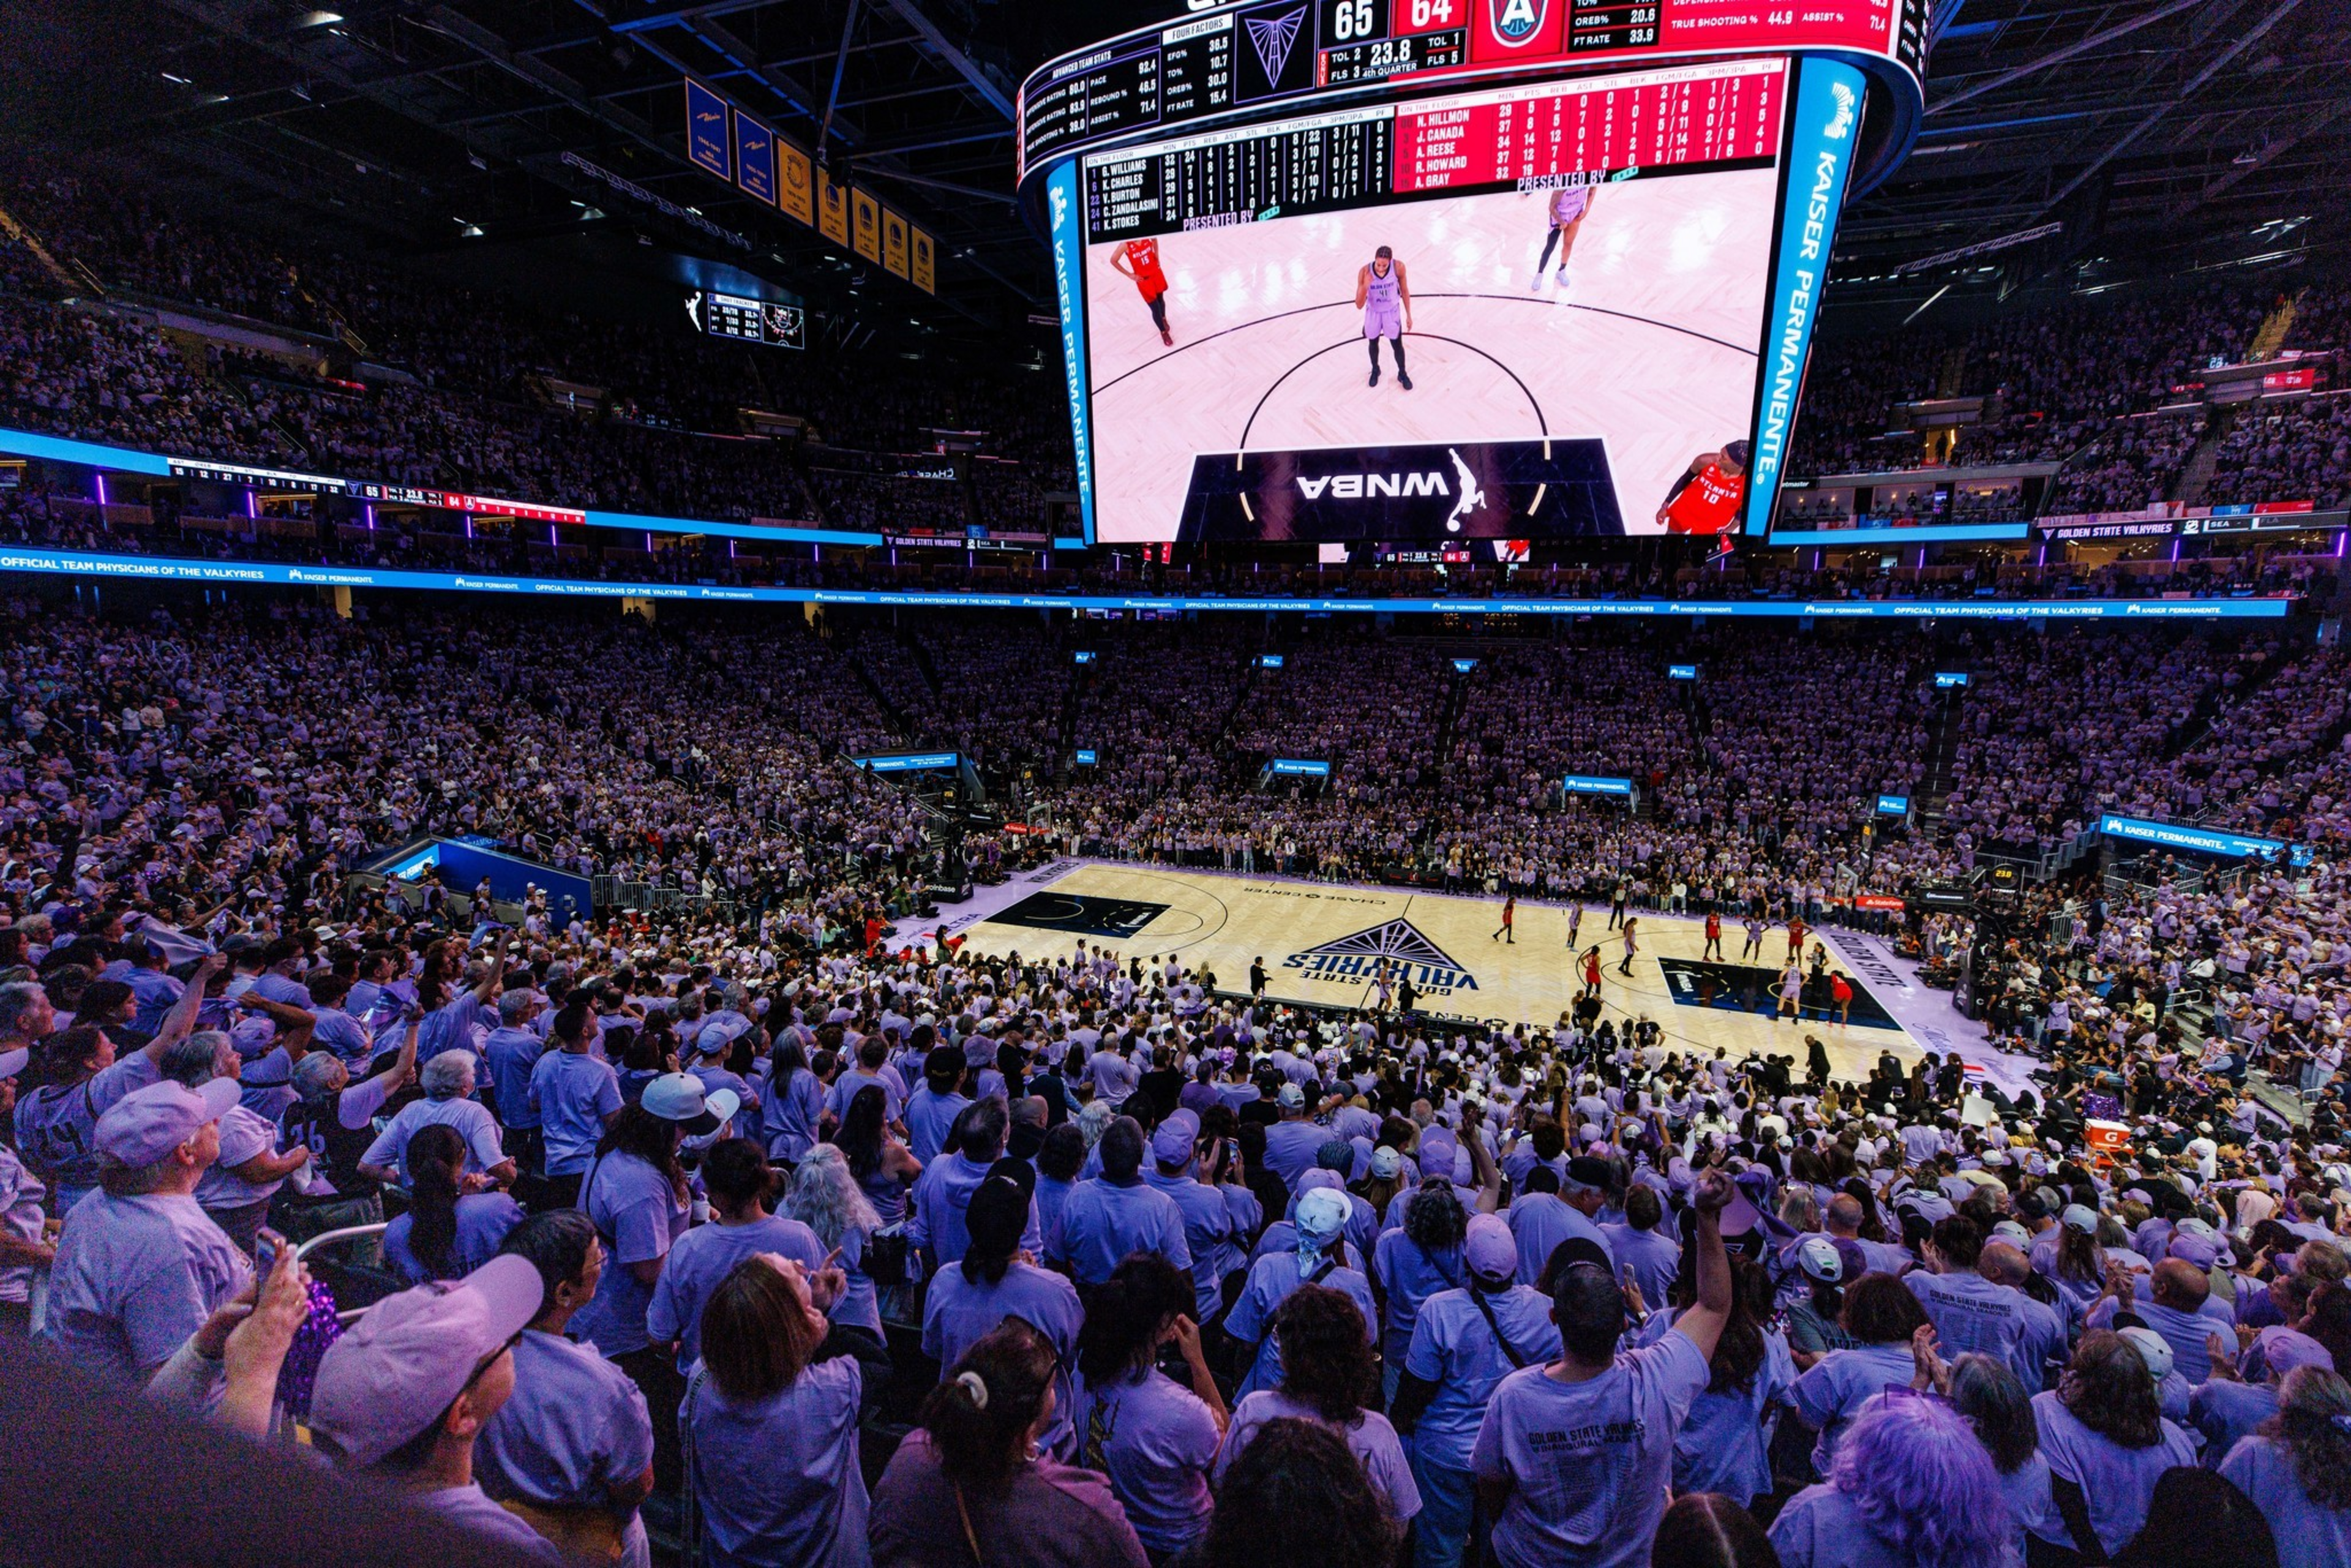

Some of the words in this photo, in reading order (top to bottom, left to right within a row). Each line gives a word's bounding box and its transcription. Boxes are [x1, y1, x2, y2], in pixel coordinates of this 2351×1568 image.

[1335, 0, 1373, 40] 65
[1411, 0, 1452, 27] 64
[1575, 15, 1609, 26] OREB%
[1630, 8, 1655, 23] 20.6
[1672, 19, 1695, 29] TRUE
[1698, 16, 1747, 28] SHOOTING
[1768, 11, 1793, 25] 44.9
[1802, 12, 1834, 22] ASSIST
[1870, 15, 1886, 31] 71.4
[1172, 26, 1190, 40] FOUR
[1191, 18, 1223, 35] FACTORS
[1574, 37, 1585, 46] FT
[1587, 34, 1610, 45] RATE
[1630, 28, 1654, 43] 33.9
[1428, 37, 1447, 48] TOL
[1454, 32, 1460, 45] 1
[1167, 49, 1188, 61] EFG%
[1331, 52, 1349, 63] TOL
[1354, 47, 1361, 61] 2
[1370, 39, 1411, 67] 23.8
[1427, 55, 1445, 66] FLS
[1451, 50, 1458, 64] 5
[1052, 62, 1079, 80] ADVANCED
[1079, 56, 1093, 70] TEAM
[1094, 50, 1112, 64] STATS
[1090, 75, 1107, 88] PACE
[1138, 58, 1157, 75] 92.4
[1168, 67, 1183, 78] TO%
[1210, 54, 1228, 70] 10.7
[1331, 70, 1348, 81] FLS
[1353, 65, 1360, 79] 3
[1362, 69, 1376, 78] 4th
[1378, 62, 1417, 76] QUARTER
[1046, 88, 1066, 104] RATING
[1069, 80, 1086, 96] 80.0
[1167, 82, 1193, 96] OREB%
[1207, 72, 1228, 88] 30.0
[1090, 91, 1120, 107] REBOUND
[1166, 103, 1176, 113] FT
[1176, 99, 1194, 110] RATE
[1209, 89, 1228, 105] 15.4
[1046, 107, 1066, 122] RATING
[1090, 112, 1112, 126] ASSIST
[1140, 99, 1157, 114] 71.4
[1417, 116, 1427, 129] N.
[1429, 109, 1470, 127] HILLMON
[1069, 118, 1086, 133] 39.0
[1416, 131, 1425, 144] J.
[1427, 126, 1464, 143] CANADA
[1112, 151, 1134, 160] FLOOR
[1415, 146, 1425, 159] A.
[1427, 141, 1456, 157] REESE
[1110, 159, 1147, 176] WILLIAMS
[1415, 161, 1425, 174] R.
[1427, 156, 1468, 173] HOWARD
[1103, 179, 1110, 191] K.
[1111, 173, 1144, 190] CHARLES
[1415, 176, 1424, 189] A.
[1426, 173, 1450, 187] GRAY
[1517, 171, 1586, 192] PRESENTED
[1589, 169, 1607, 184] BY
[1103, 193, 1111, 204] V.
[1111, 187, 1141, 203] BURTON
[1103, 206, 1111, 218] C.
[1112, 198, 1159, 216] ZANDALASINI
[1800, 151, 1837, 261] KAISER
[1104, 219, 1111, 231] K.
[1112, 214, 1140, 230] STOKES
[1183, 211, 1238, 232] PRESENTED
[1240, 209, 1254, 223] BY
[1054, 239, 1071, 323] KAISER
[366, 486, 379, 497] 65
[405, 489, 424, 500] 23.8
[1296, 471, 1450, 500] WNBA
[1699, 475, 1738, 499] ATLANTA
[1702, 490, 1720, 505] 10
[2057, 527, 2090, 539] GOLDEN
[2091, 525, 2122, 538] STATE
[2123, 523, 2173, 536] VALKYRIES
[895, 538, 916, 546] GOLDEN
[1, 557, 59, 569] OFFICIAL
[61, 560, 94, 571] TEAM
[96, 562, 159, 575] PHYSICIANS
[160, 566, 176, 576] OF
[178, 567, 201, 577] THE
[203, 568, 265, 579] VALKYRIES
[535, 583, 565, 593] OFFICIAL
[2051, 607, 2104, 615] VALKYRIES
[2124, 825, 2156, 838] KAISER
[1324, 895, 1387, 906] CHASE
[1299, 970, 1363, 985] STATE
[2104, 1131, 2118, 1142] G
[1528, 1431, 1567, 1445] GOLDEN
[1569, 1425, 1602, 1439] STATE
